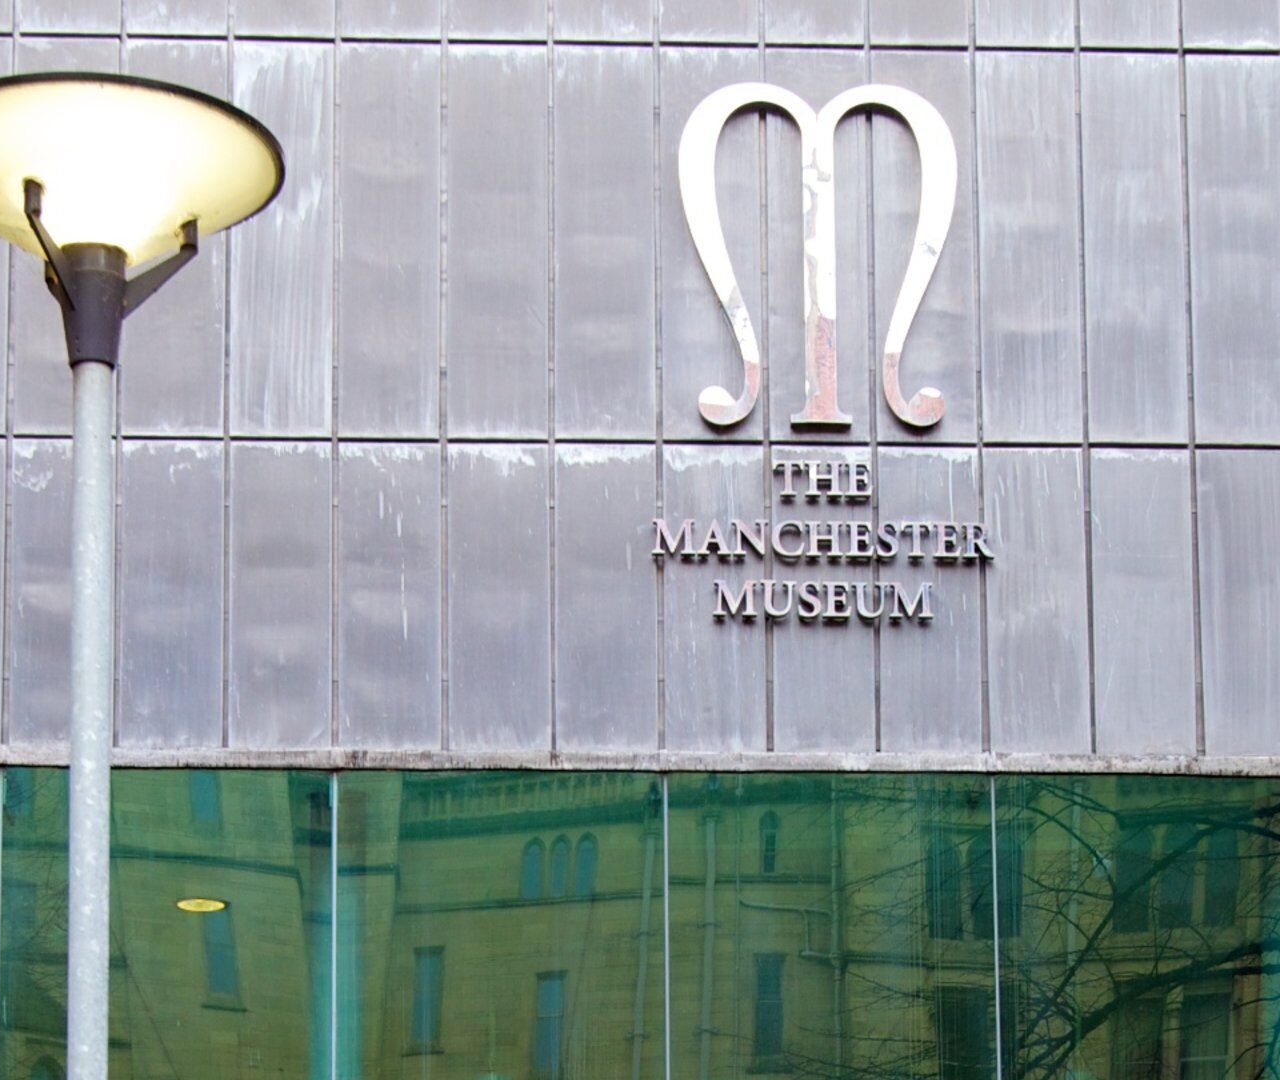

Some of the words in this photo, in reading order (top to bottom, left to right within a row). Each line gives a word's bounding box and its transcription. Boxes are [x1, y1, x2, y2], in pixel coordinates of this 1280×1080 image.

[773, 460, 873, 501] THE
[652, 518, 995, 562] MANCHESTER
[713, 580, 934, 622] MUSEUM
